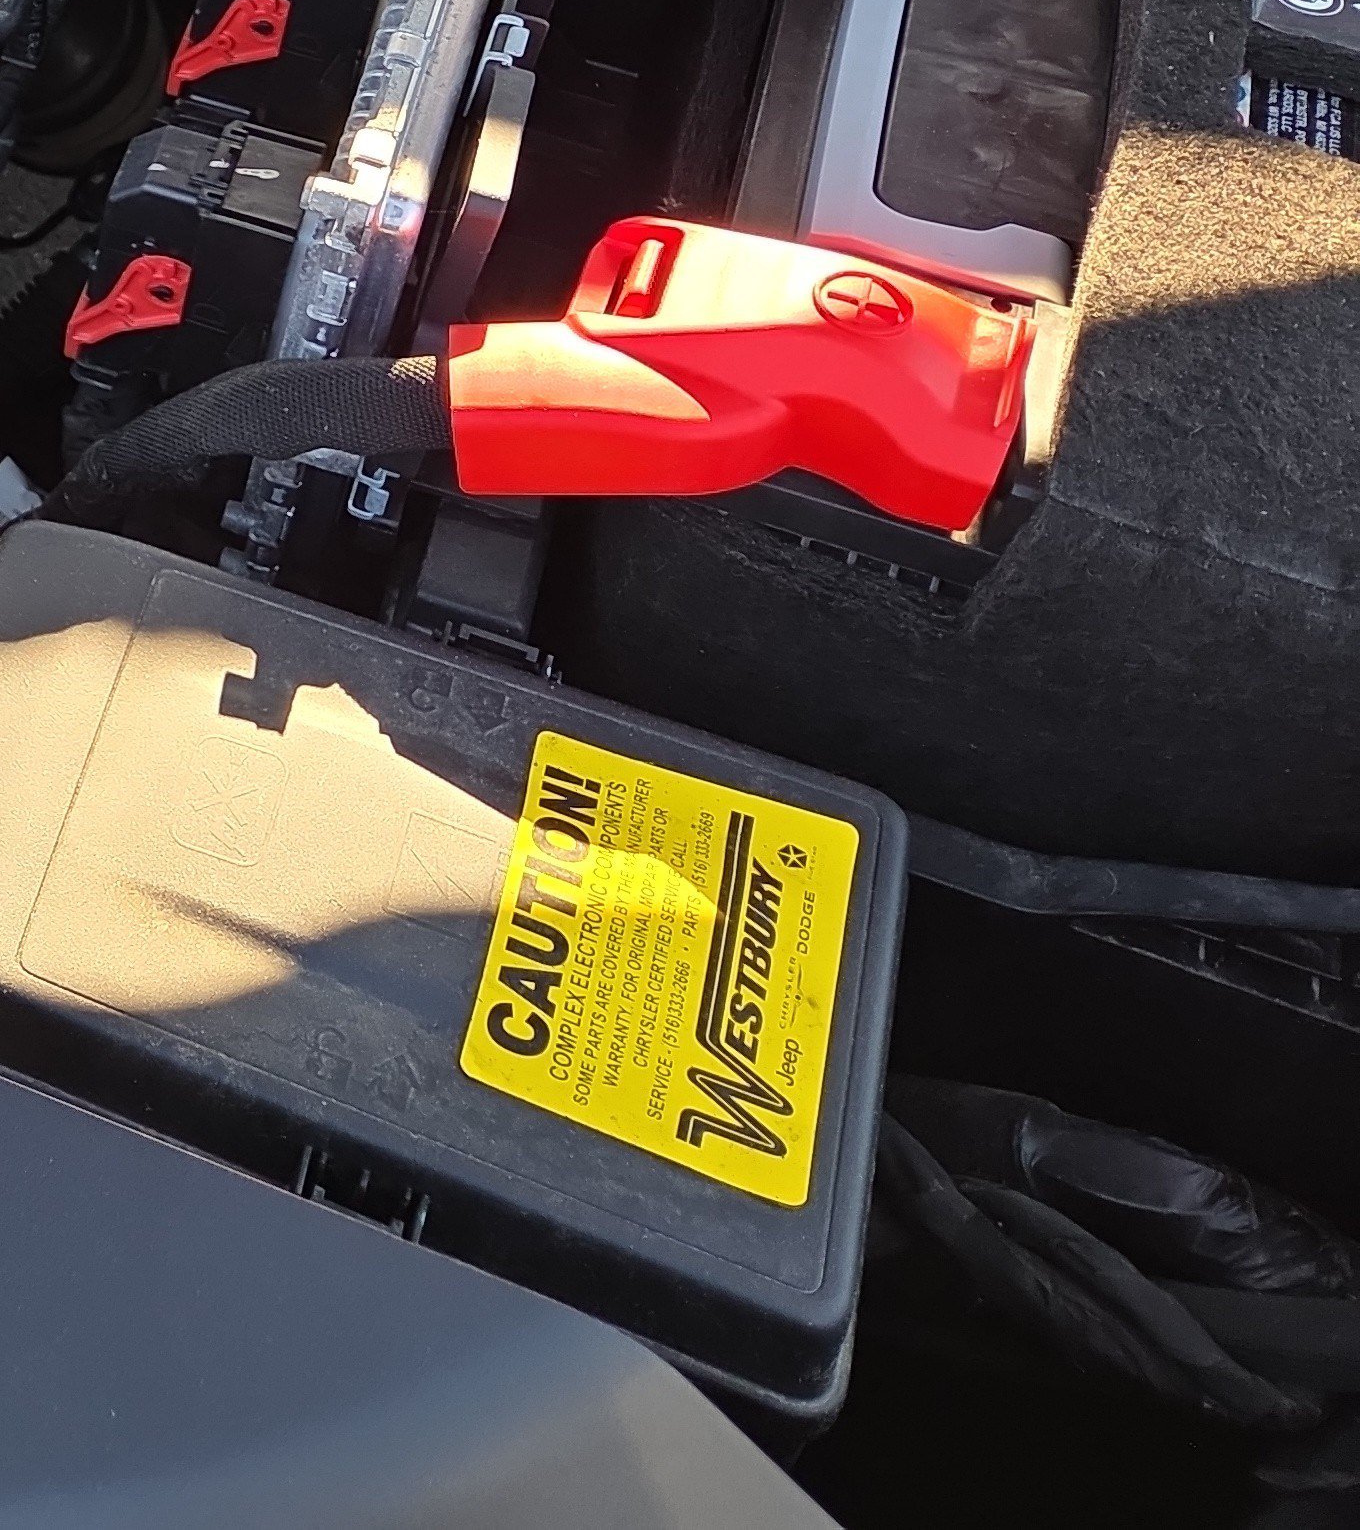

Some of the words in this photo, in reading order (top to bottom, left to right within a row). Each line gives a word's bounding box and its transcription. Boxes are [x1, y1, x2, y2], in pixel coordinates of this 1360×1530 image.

[620, 777, 653, 868] MANUFACTURER
[646, 824, 666, 860] PARTS
[652, 806, 669, 826] OR
[692, 810, 716, 859] 333-2669
[617, 870, 634, 895] THE
[637, 861, 660, 908] MOPAR
[659, 868, 683, 924] SERVICE
[688, 857, 712, 889] (516)
[487, 765, 600, 1055] CAUTION!
[548, 989, 586, 1083] COMPLEX
[568, 882, 609, 989] ELECTRONIC
[589, 780, 629, 881] COMPONENTS
[613, 896, 629, 915] BY
[680, 895, 702, 938] PARTS
[795, 889, 816, 955] DODGE
[599, 915, 626, 980] COVERED
[625, 908, 652, 971] ORIGINAL
[646, 923, 673, 993] CERTIFIED
[593, 980, 613, 1011] ARE
[619, 970, 639, 1001] FOR
[659, 958, 694, 1049] (516)333-2666
[675, 838, 794, 1157] WESTBURY
[778, 955, 797, 1030] CHRYSLER
[582, 1010, 607, 1059] PARTS
[631, 992, 660, 1069] CHRYSLER
[572, 1060, 596, 1107] SOME
[646, 1055, 673, 1121] SERVICE
[774, 1035, 804, 1089] Jeep
